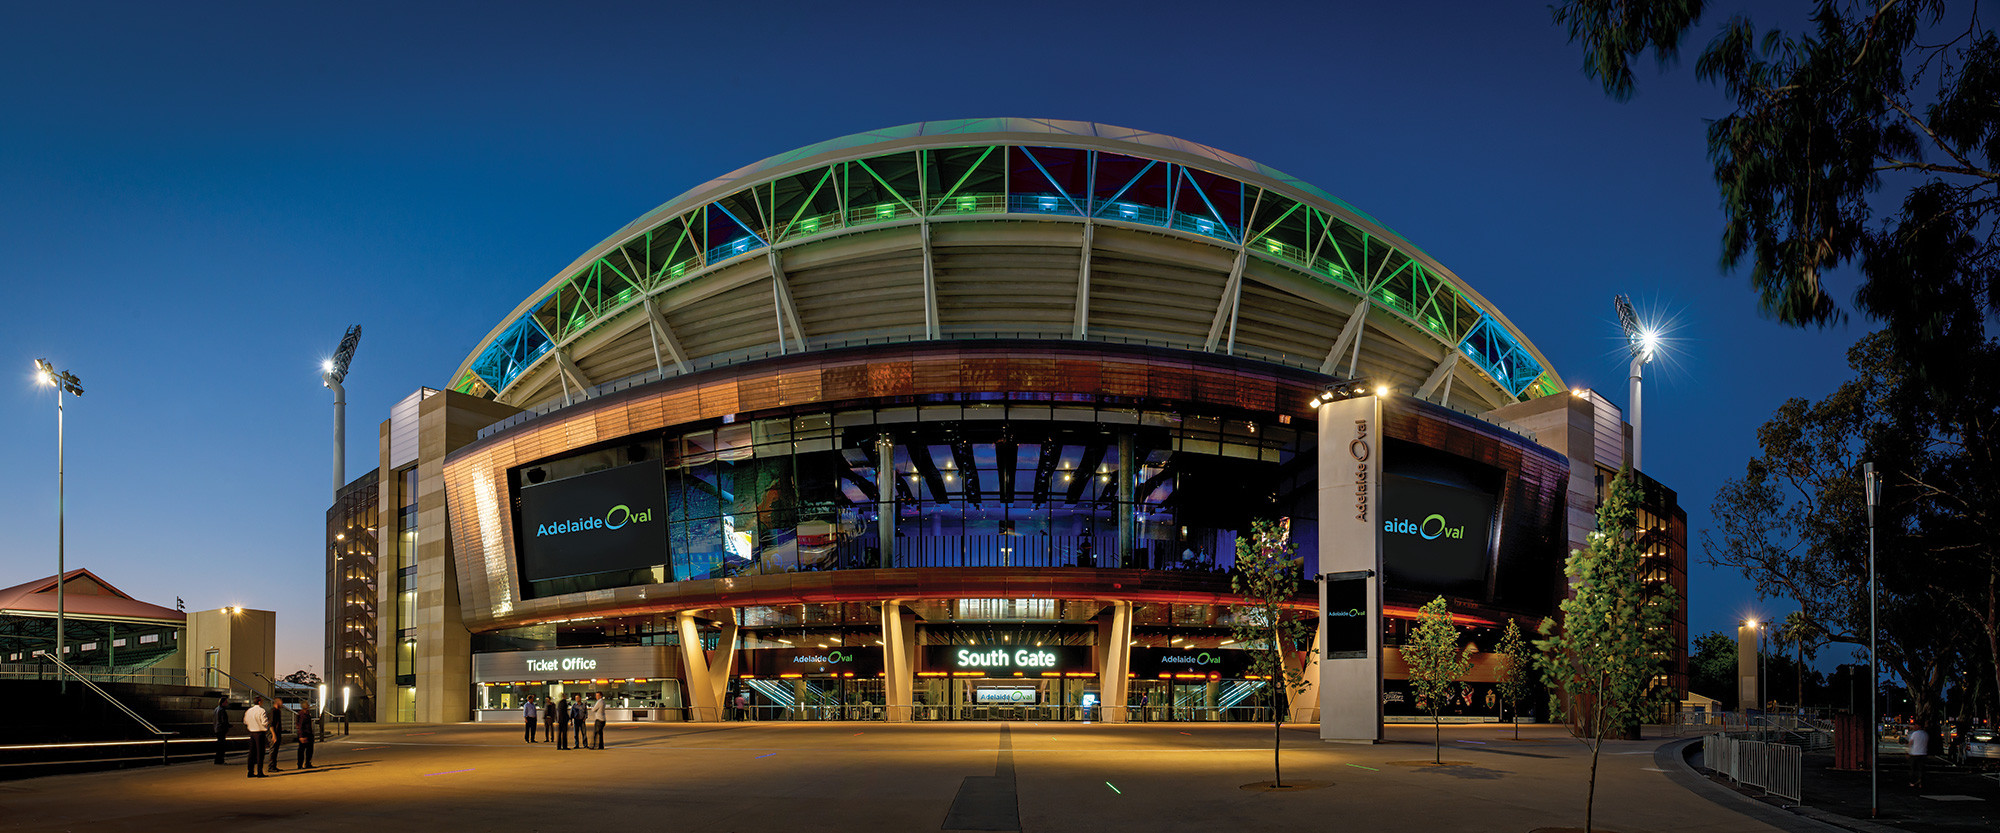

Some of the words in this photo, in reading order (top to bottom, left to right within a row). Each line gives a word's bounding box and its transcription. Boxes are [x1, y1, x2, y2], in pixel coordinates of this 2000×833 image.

[1349, 419, 1369, 462] Oval
[1355, 463, 1367, 522] Adelaide
[537, 517, 603, 537] Adelaide
[605, 504, 652, 530] Oval
[1420, 513, 1464, 540] Oval
[526, 659, 559, 672] Ticket
[562, 657, 597, 671] Office
[793, 654, 827, 663] Adelaide
[828, 650, 853, 664] Oval
[957, 649, 1010, 667] South
[1014, 649, 1056, 667] Gate
[1161, 655, 1196, 664] Adelaide
[1197, 652, 1221, 665] Oval
[980, 693, 1011, 701] Adelaide
[1011, 690, 1033, 702] Oval
